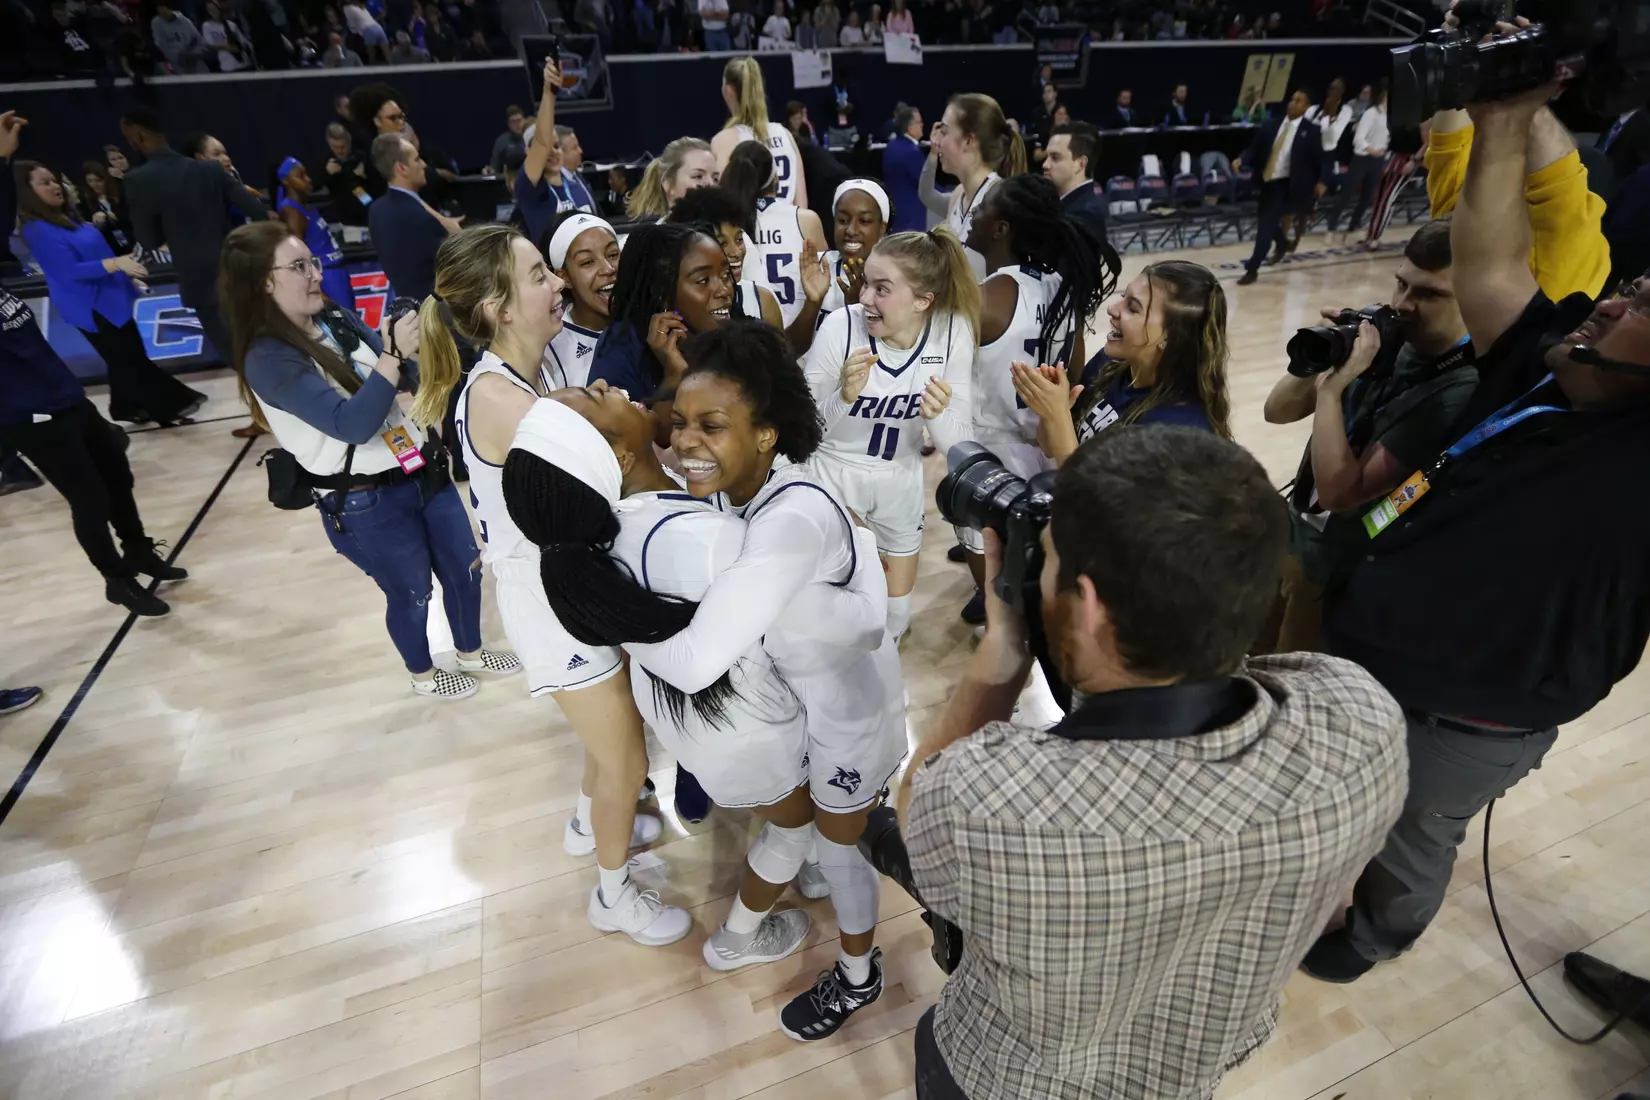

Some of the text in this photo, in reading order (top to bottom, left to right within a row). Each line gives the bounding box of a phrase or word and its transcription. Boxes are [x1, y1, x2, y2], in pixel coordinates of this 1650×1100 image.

[765, 253, 796, 305] 5
[848, 393, 921, 420] RICE
[866, 422, 900, 461] 11
